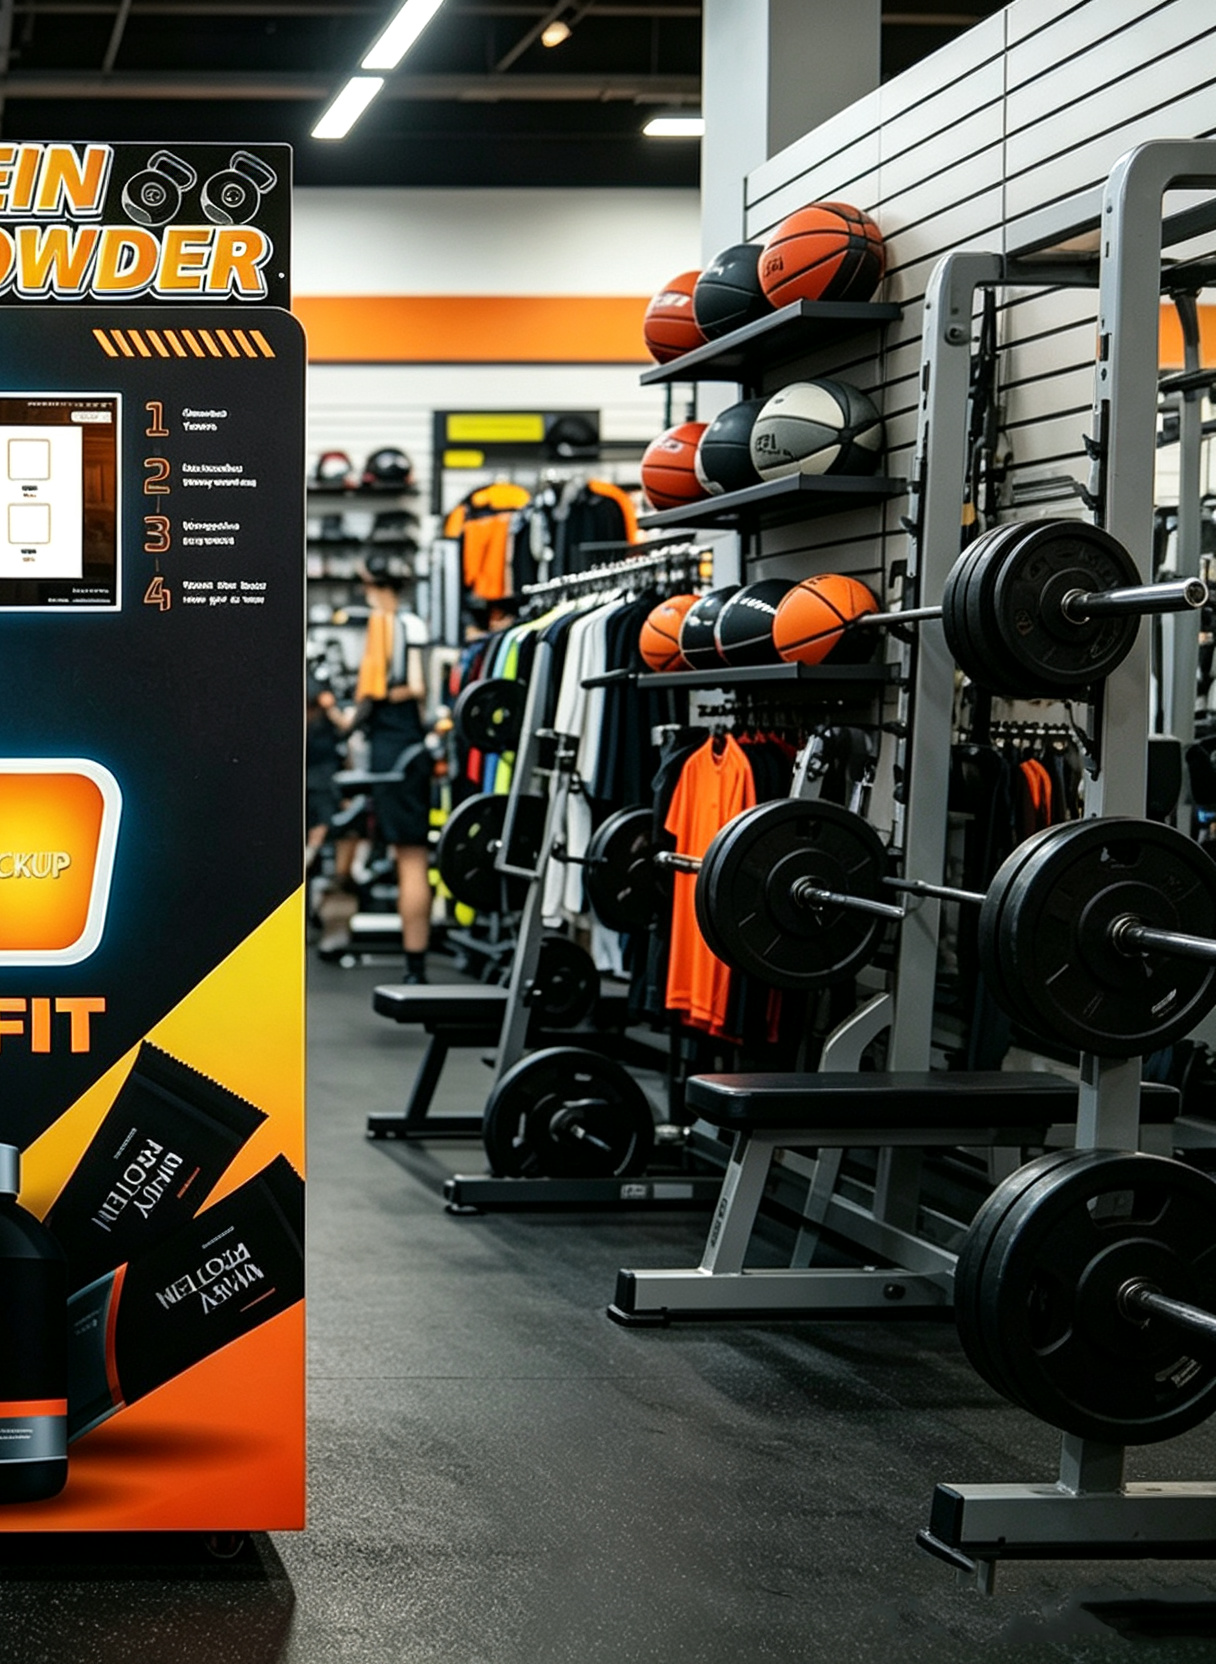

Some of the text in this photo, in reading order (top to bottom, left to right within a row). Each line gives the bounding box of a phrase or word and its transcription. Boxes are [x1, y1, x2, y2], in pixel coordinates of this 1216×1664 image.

[145, 401, 170, 437] 1
[144, 457, 171, 494] 2
[144, 515, 171, 552] 3
[144, 576, 171, 611] 4
